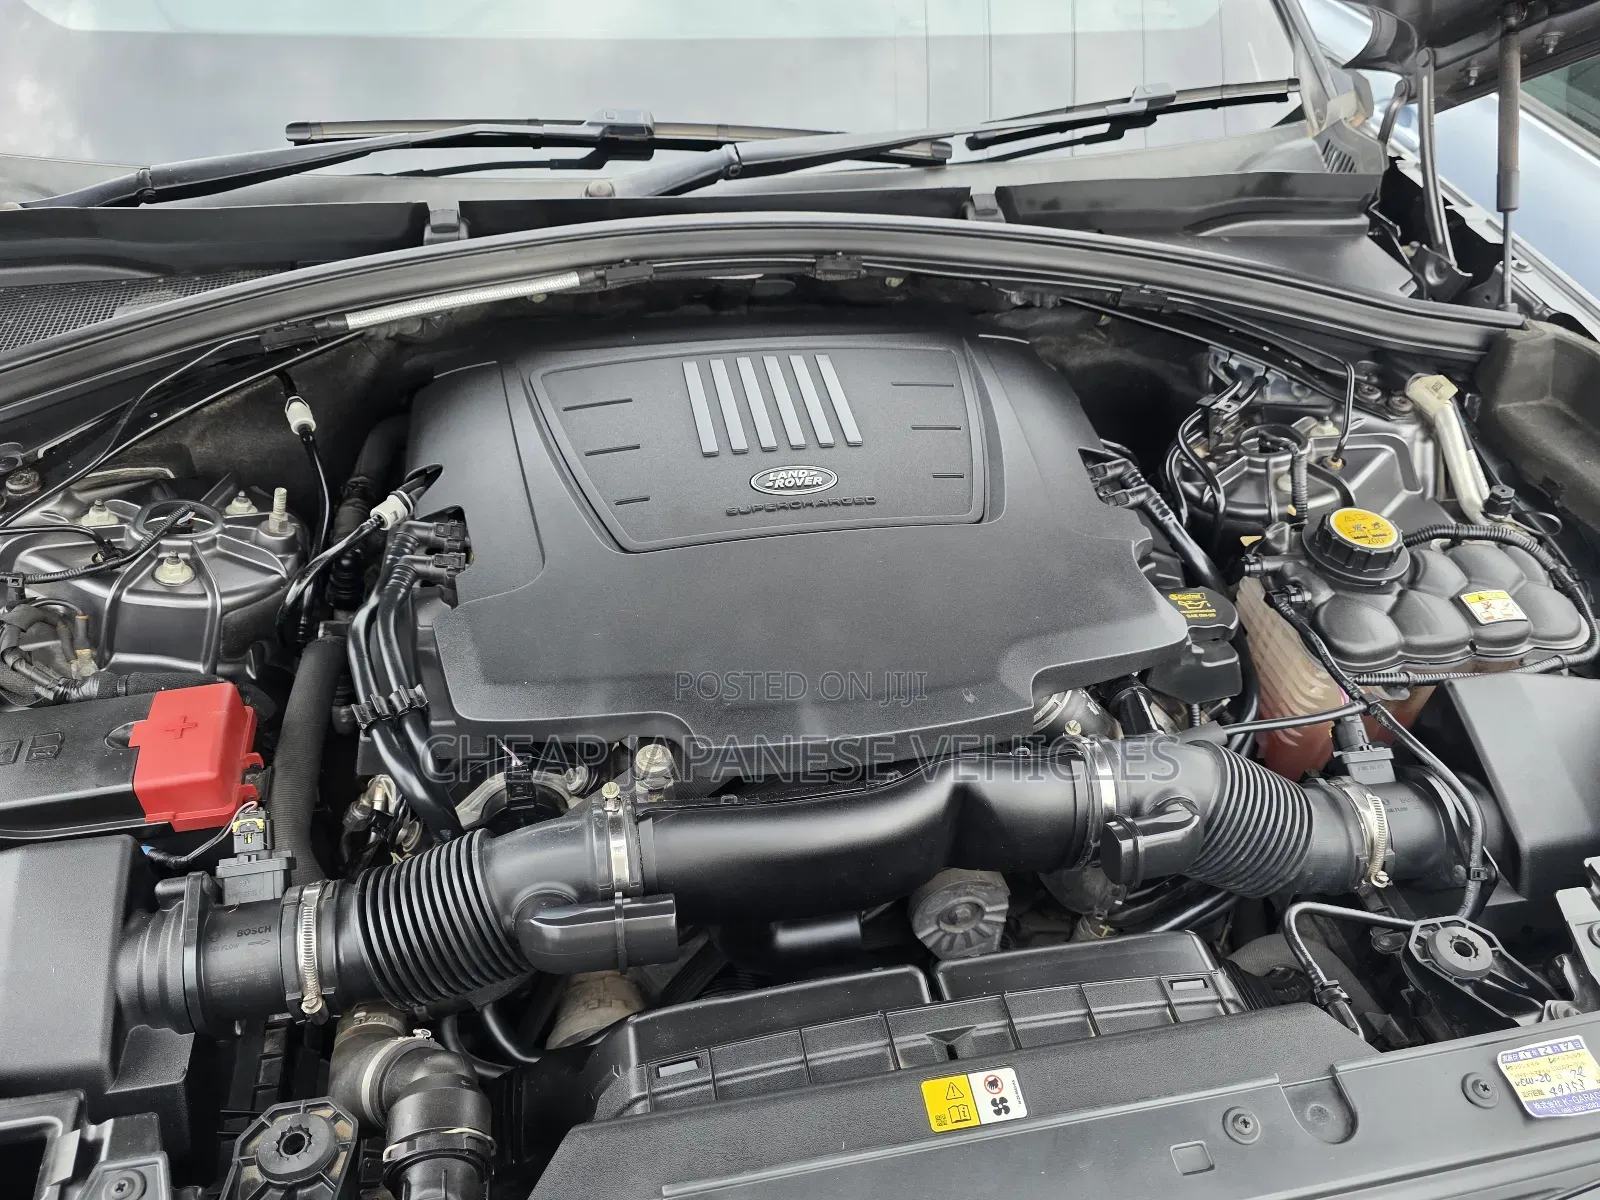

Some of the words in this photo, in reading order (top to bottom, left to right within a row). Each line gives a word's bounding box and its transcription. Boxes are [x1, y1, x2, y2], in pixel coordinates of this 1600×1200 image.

[769, 470, 807, 480] LAND
[775, 477, 822, 488] ROVER
[726, 496, 876, 516] SUPERCHARGED
[236, 925, 272, 938] BOSCH
